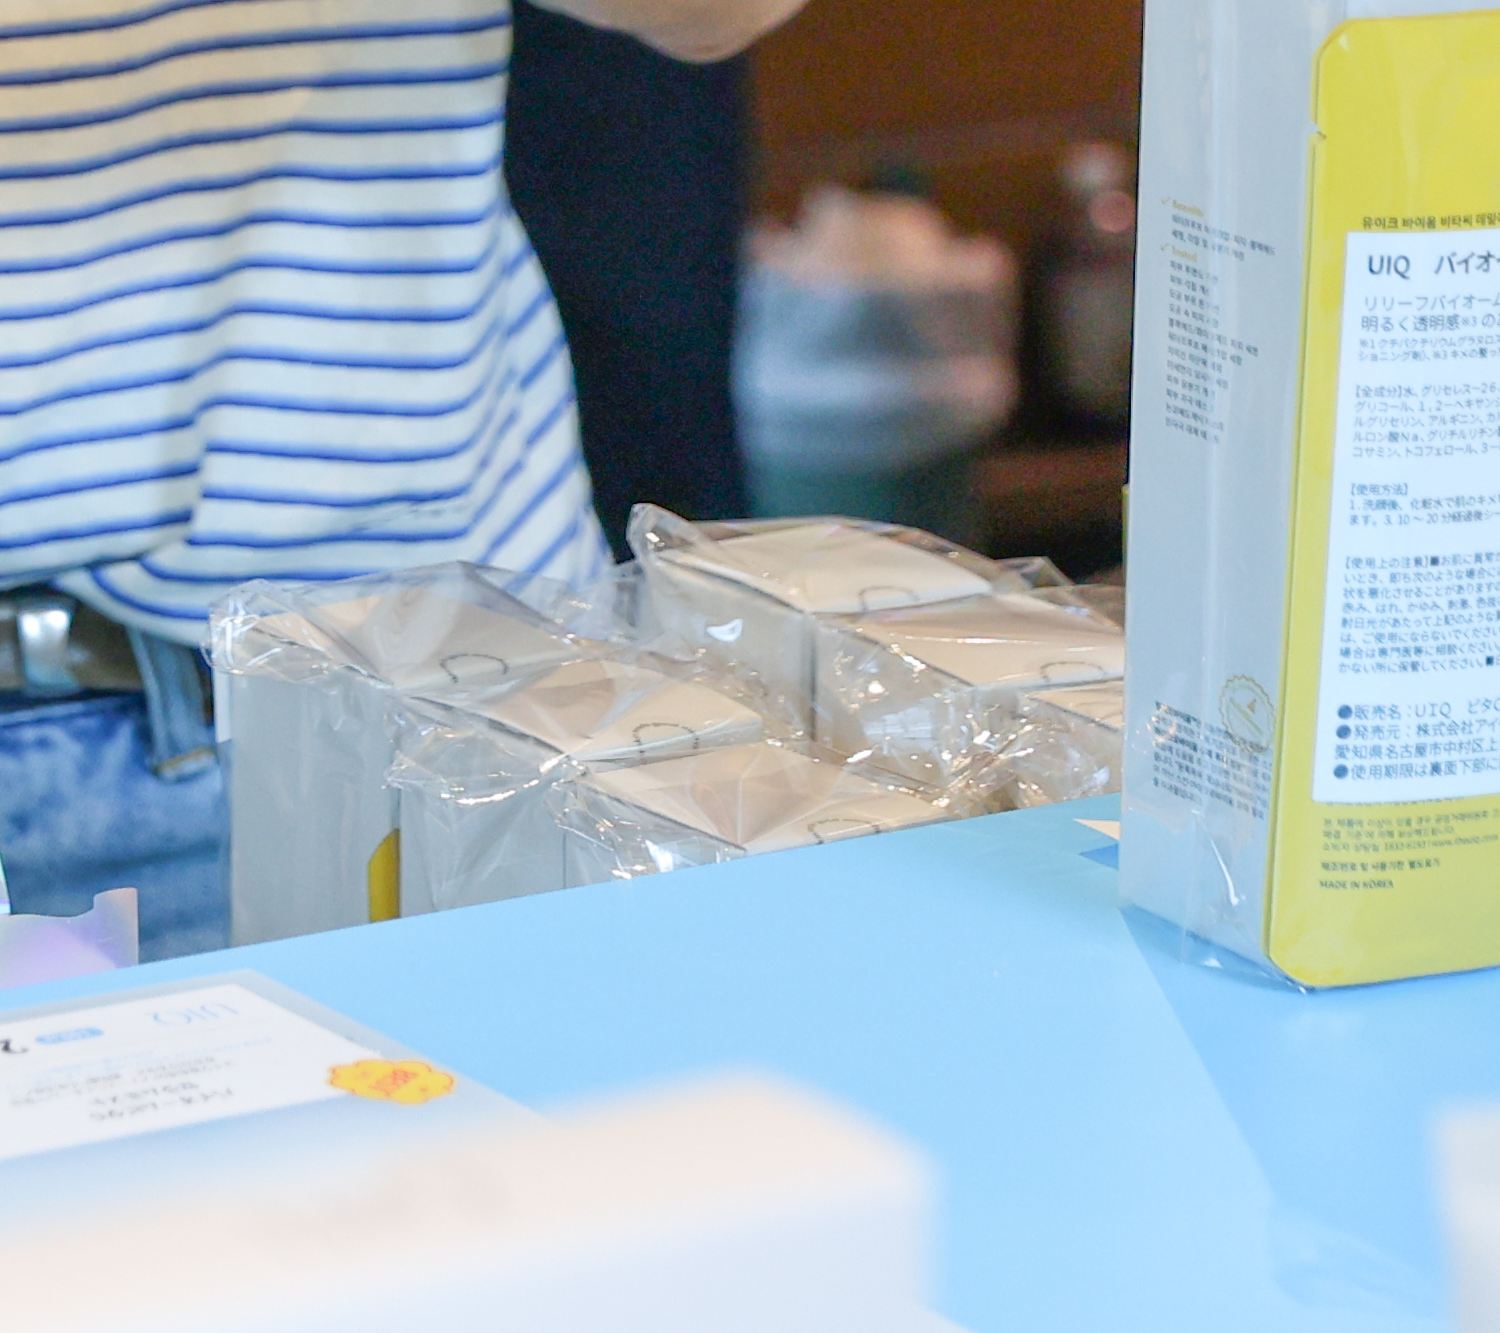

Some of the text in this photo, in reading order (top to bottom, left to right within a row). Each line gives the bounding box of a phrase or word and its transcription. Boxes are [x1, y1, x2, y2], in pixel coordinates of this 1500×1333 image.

[1368, 254, 1411, 280] UIQ
[1319, 878, 1395, 890] MADE IN KOREA
